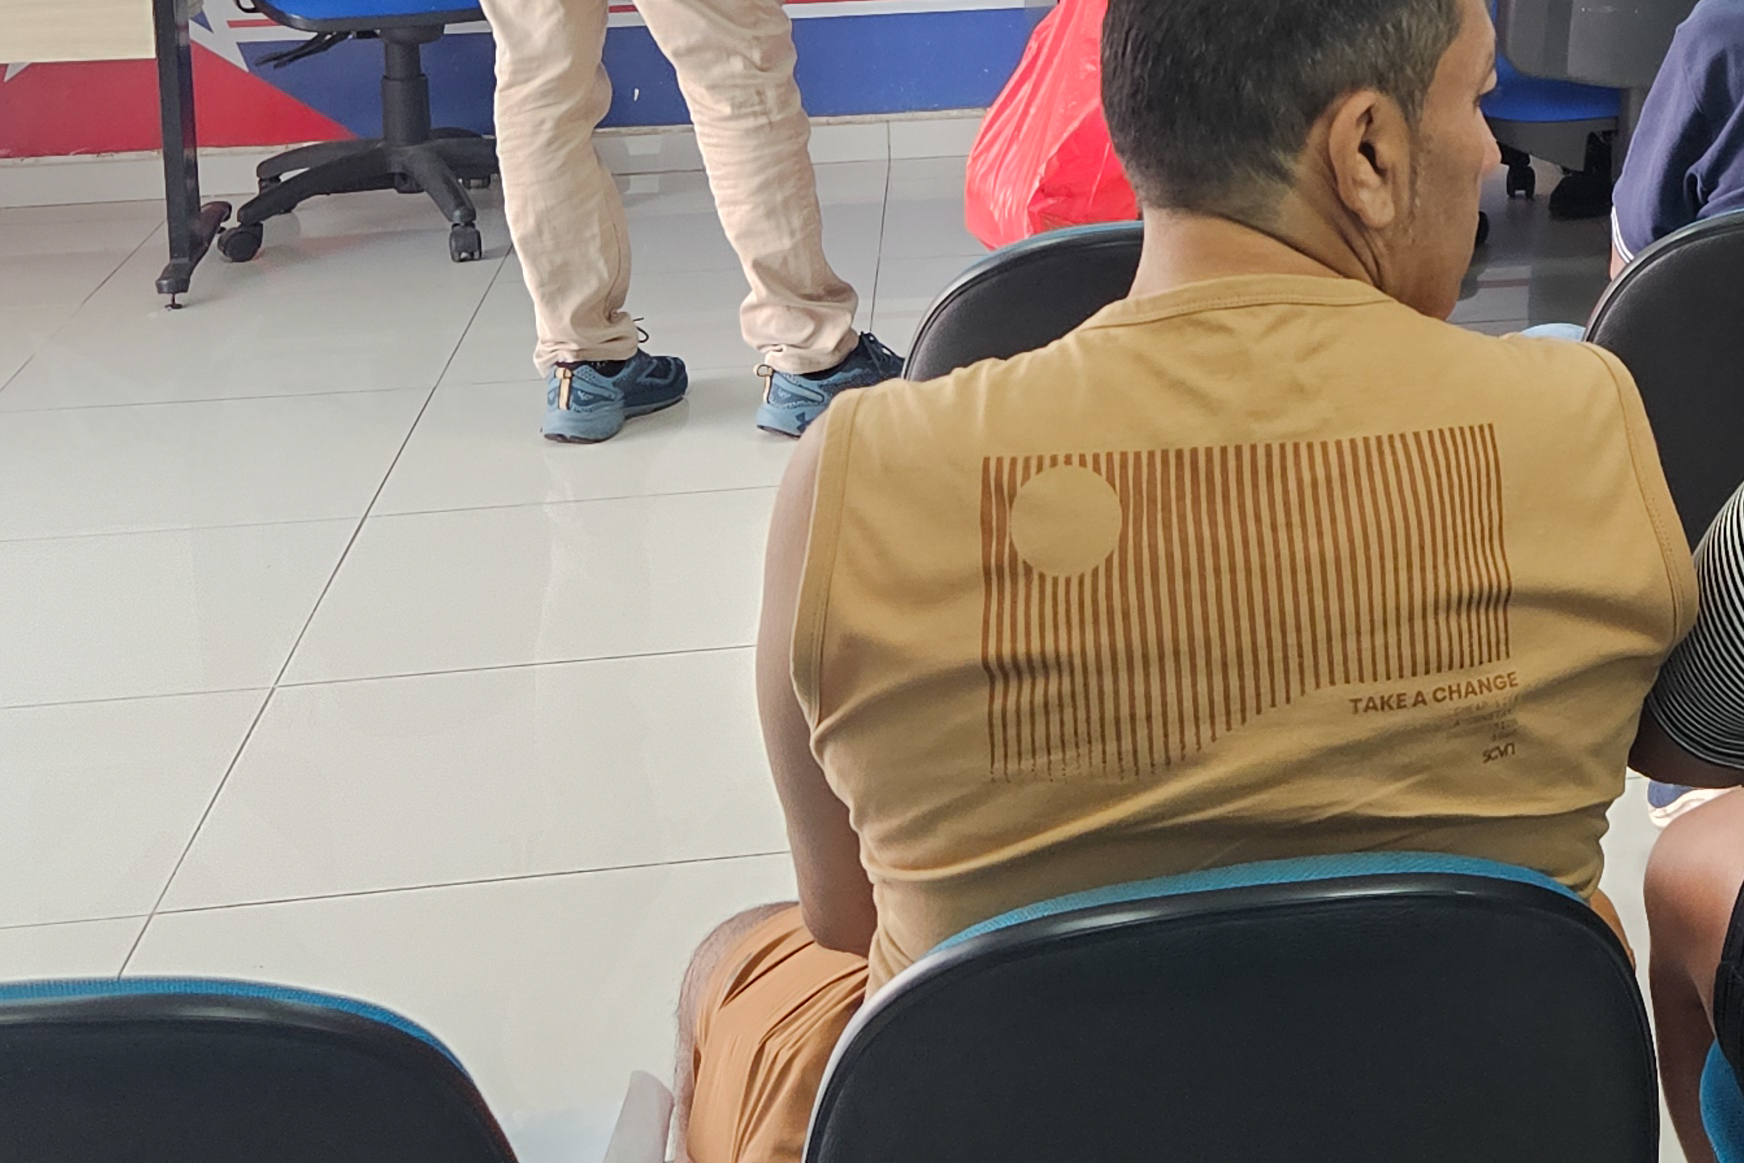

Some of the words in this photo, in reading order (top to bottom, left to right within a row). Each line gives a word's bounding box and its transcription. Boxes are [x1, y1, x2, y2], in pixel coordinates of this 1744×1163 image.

[1350, 690, 1408, 715] TAKE
[1411, 690, 1428, 708] A
[1432, 671, 1520, 704] CHANGE
